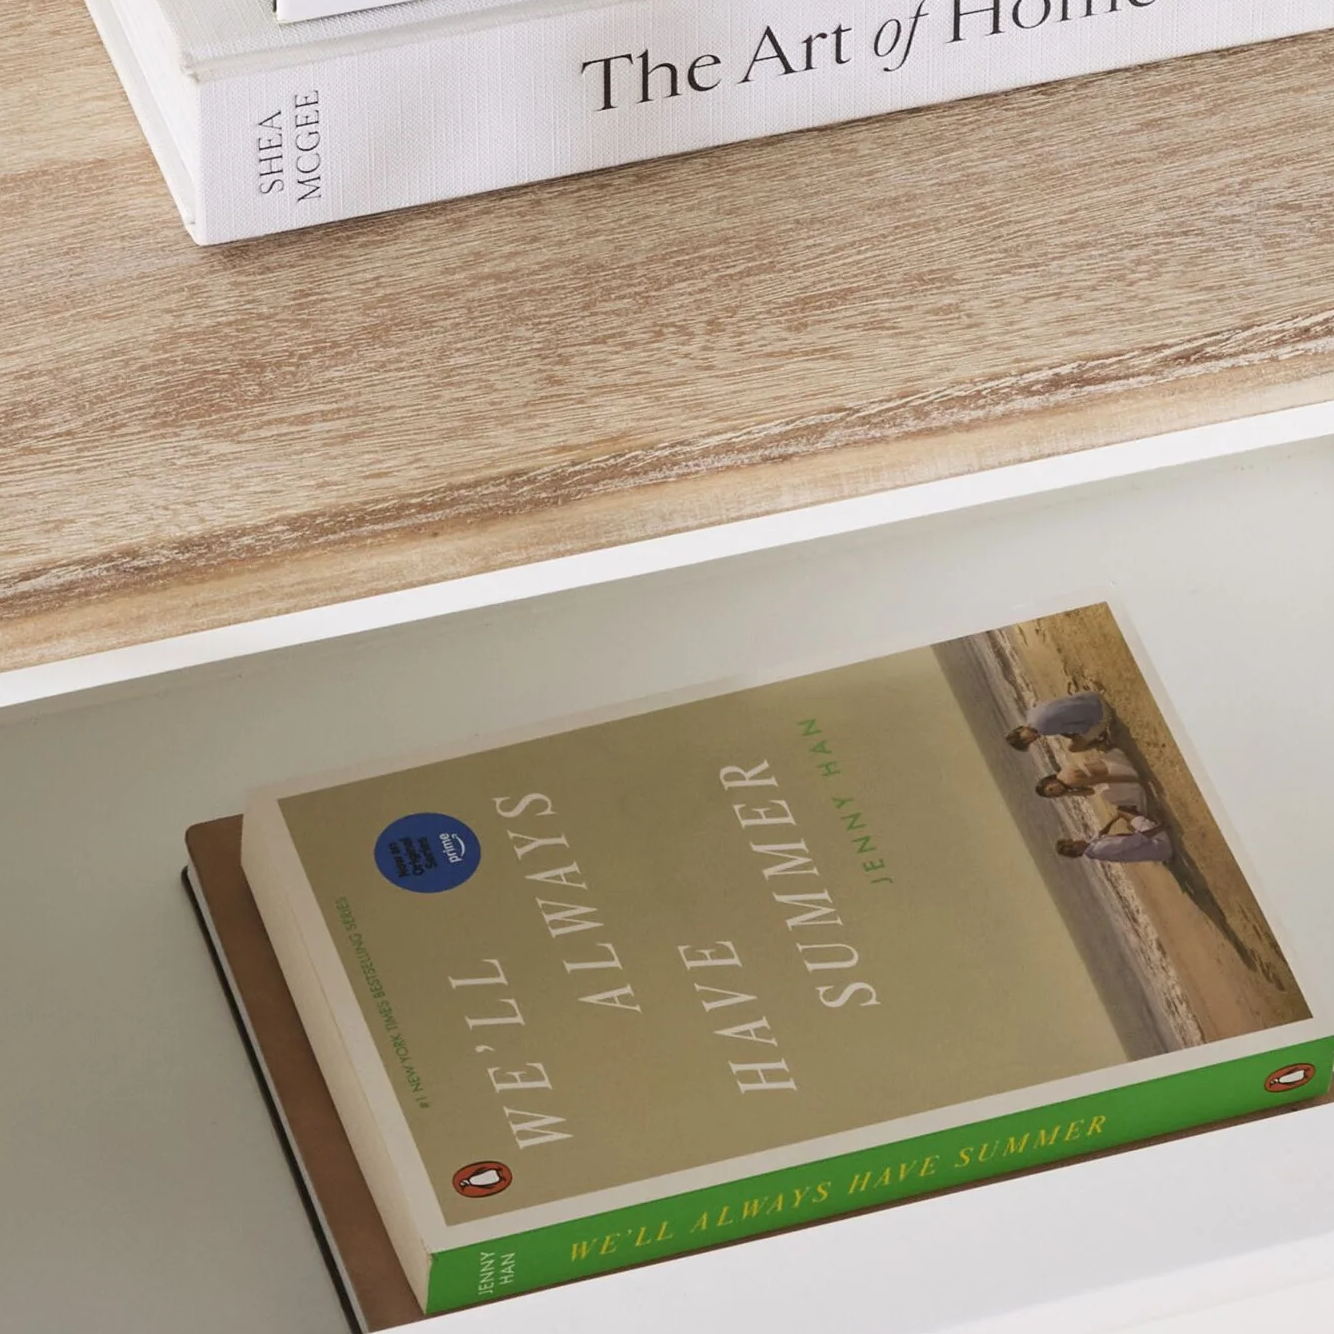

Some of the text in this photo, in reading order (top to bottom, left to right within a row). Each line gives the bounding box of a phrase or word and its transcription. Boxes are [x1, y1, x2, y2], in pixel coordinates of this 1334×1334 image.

[580, 47, 723, 112] The
[736, 22, 853, 85] Art
[257, 109, 285, 195] SHEA
[294, 89, 322, 203] MCGEE
[438, 832, 463, 864] prime
[796, 718, 894, 885] JENNY HAN
[491, 792, 643, 1015] ALWAYS
[719, 758, 882, 1009] SUMMER
[335, 895, 431, 1110] #1 NEW YORK TIMES BESTSELLING SERIES
[448, 957, 574, 1150] WE'LL
[677, 939, 798, 1095] HAVE
[569, 1114, 1108, 1264] WE'LL ALWAYS HAVE SUMMER
[477, 1251, 496, 1296] JENNY
[498, 1252, 516, 1286] HAN
